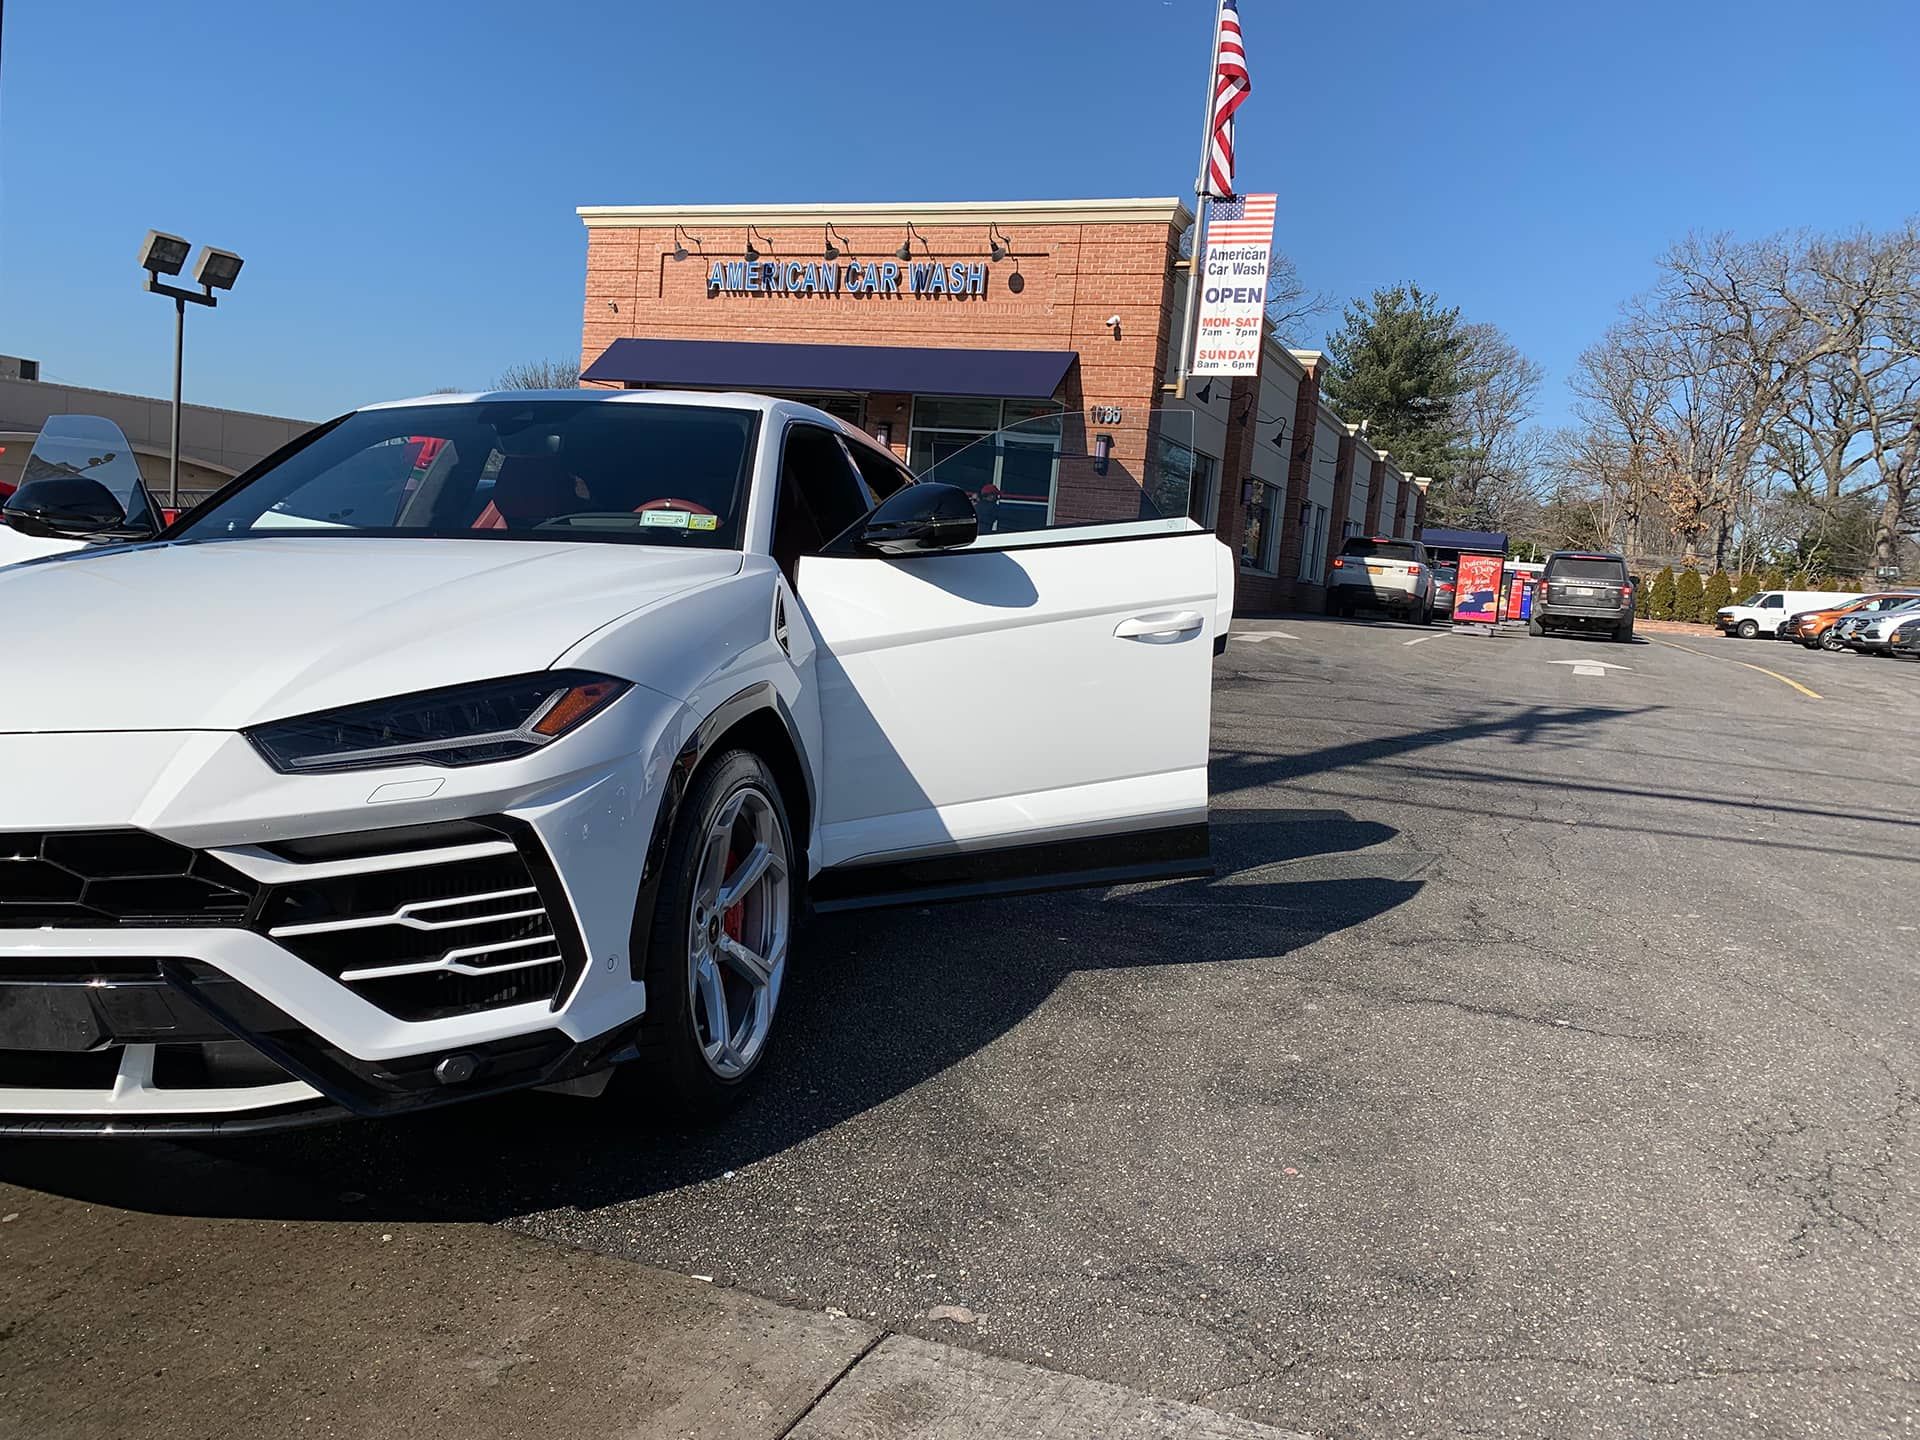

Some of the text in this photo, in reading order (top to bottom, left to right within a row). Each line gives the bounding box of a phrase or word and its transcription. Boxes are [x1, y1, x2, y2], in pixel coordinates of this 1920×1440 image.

[1209, 248, 1267, 261] American
[1208, 262, 1265, 276] Car Wash
[709, 261, 986, 294] AMERICAN CAR WASH
[1205, 287, 1263, 304] OPEN
[1202, 317, 1260, 328] MON-SAT
[1201, 328, 1222, 336] 7am
[1235, 328, 1258, 337] 7pm
[1199, 350, 1255, 360] SUNDAY
[1196, 360, 1219, 369] 8am
[1231, 361, 1255, 370] 6pm
